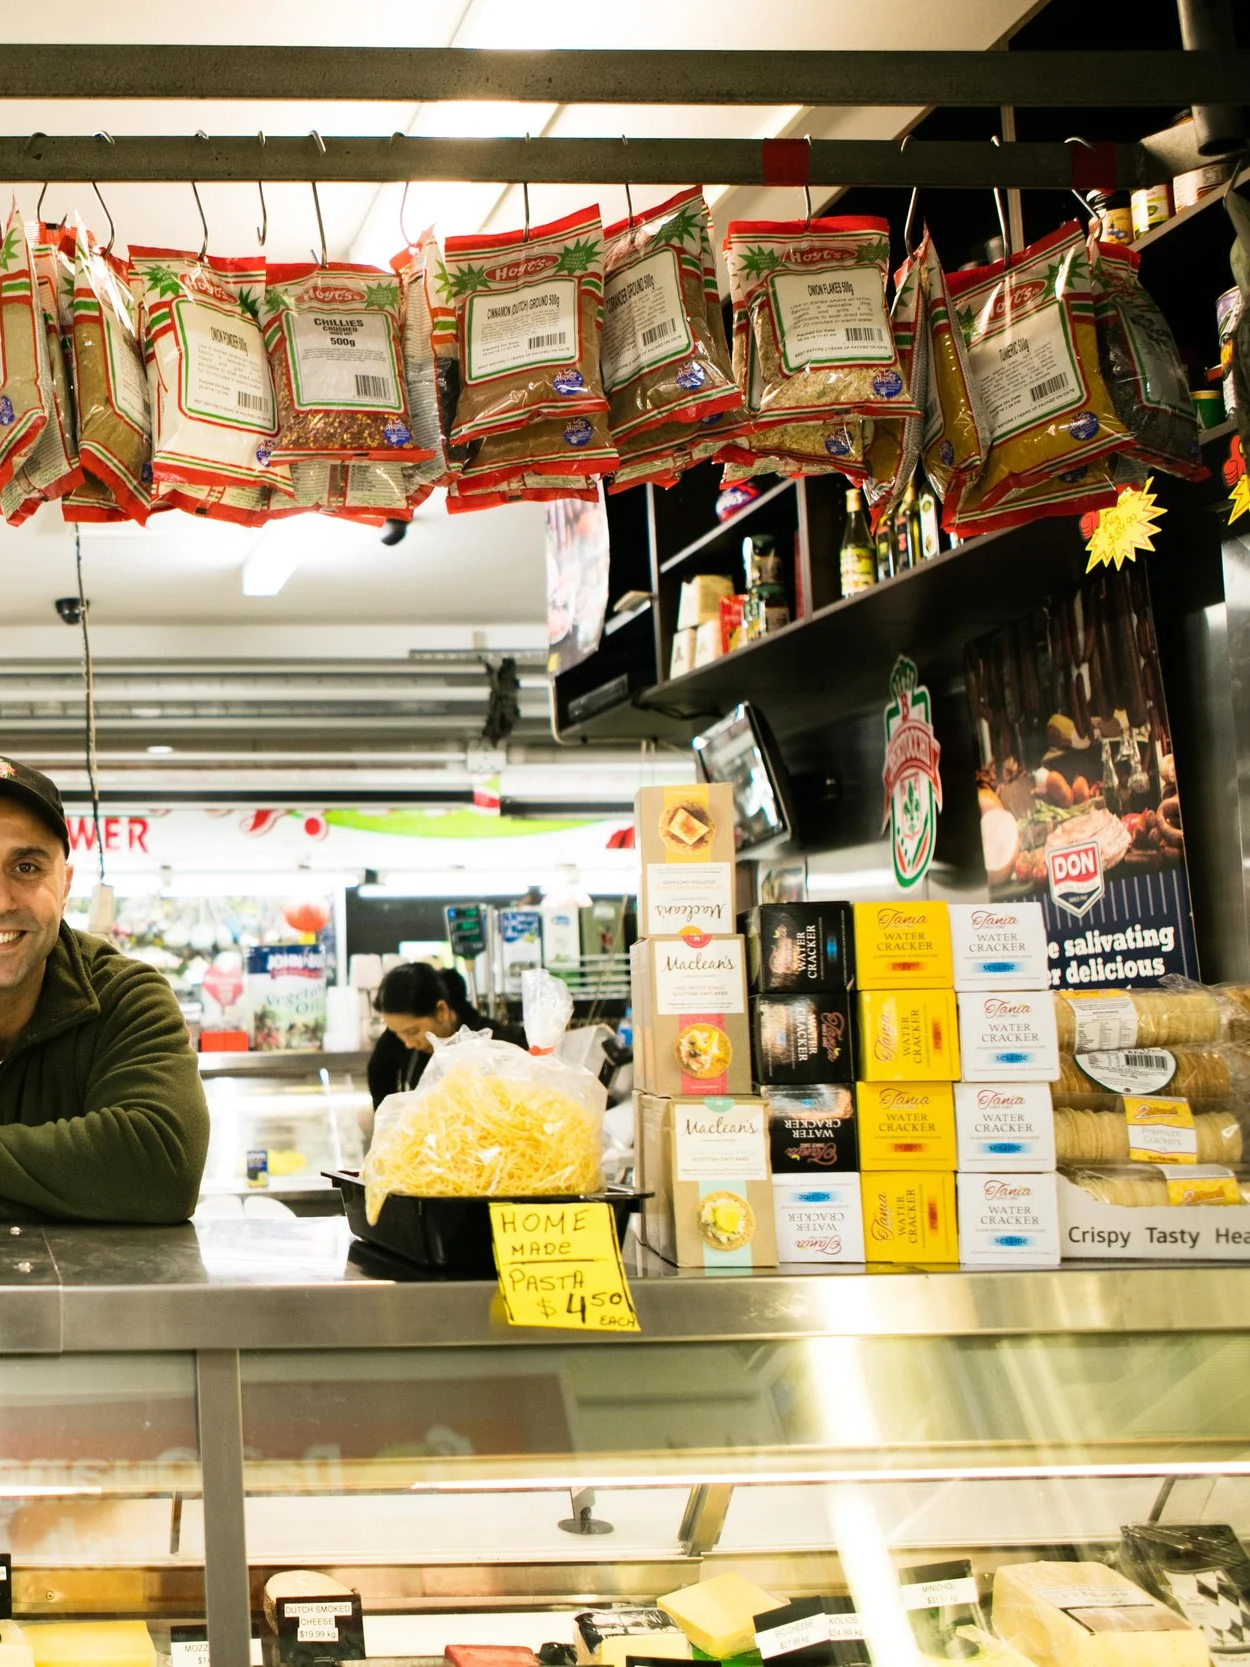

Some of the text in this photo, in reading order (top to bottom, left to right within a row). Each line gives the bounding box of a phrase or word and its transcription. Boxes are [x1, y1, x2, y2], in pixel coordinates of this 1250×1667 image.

[808, 284, 824, 296] ONION
[823, 282, 842, 294] FLAKES
[487, 306, 510, 320] CINNAMON
[530, 298, 548, 312] GROUND
[548, 294, 560, 308] 500g
[314, 318, 364, 327] CHILLIES
[330, 337, 356, 347] 500g
[1054, 851, 1095, 880] DON
[970, 910, 1018, 930] Tania
[976, 933, 1018, 941] WATER
[1064, 924, 1175, 952] salivating
[798, 931, 806, 972] WATER
[807, 924, 817, 979] CRACKER
[876, 942, 933, 951] CRACKER
[968, 942, 1026, 952] CRACKER
[661, 952, 736, 973] Maclean's
[1066, 955, 1165, 984] delicious
[984, 998, 1032, 1019] Tania
[988, 1023, 1031, 1032] WATER
[902, 1016, 911, 1056] WATER
[912, 1008, 922, 1064] CRACKER
[981, 1032, 1039, 1042] CRACKER
[996, 1053, 1028, 1061] sesame
[977, 1089, 1026, 1110] Tania
[886, 1113, 928, 1122] WATER
[982, 1113, 1024, 1122] WATER
[682, 1116, 758, 1136] Maclean's
[785, 1119, 842, 1128] CRACKER
[878, 1123, 936, 1132] CRACKER
[974, 1123, 1033, 1132] CRACKER
[792, 1129, 834, 1138] WATER
[984, 1180, 1032, 1200] Tania
[988, 1206, 1031, 1214] WATER
[788, 1213, 845, 1221] CRACKER
[898, 1196, 906, 1236] WATER
[907, 1188, 917, 1243] CRACKER
[980, 1216, 1039, 1225] CRACKER
[501, 1209, 590, 1234] HOME
[796, 1223, 837, 1231] WATER
[1068, 1226, 1250, 1248] Crispy Tasty Hea
[509, 1268, 584, 1292] PASTA
[600, 1315, 636, 1327] EACH
[286, 1604, 351, 1614] DUTCH SMOKED
[829, 1616, 859, 1625] KOLIOS
[327, 1631, 336, 1639] kg
[184, 1644, 209, 1652] MOZZ
